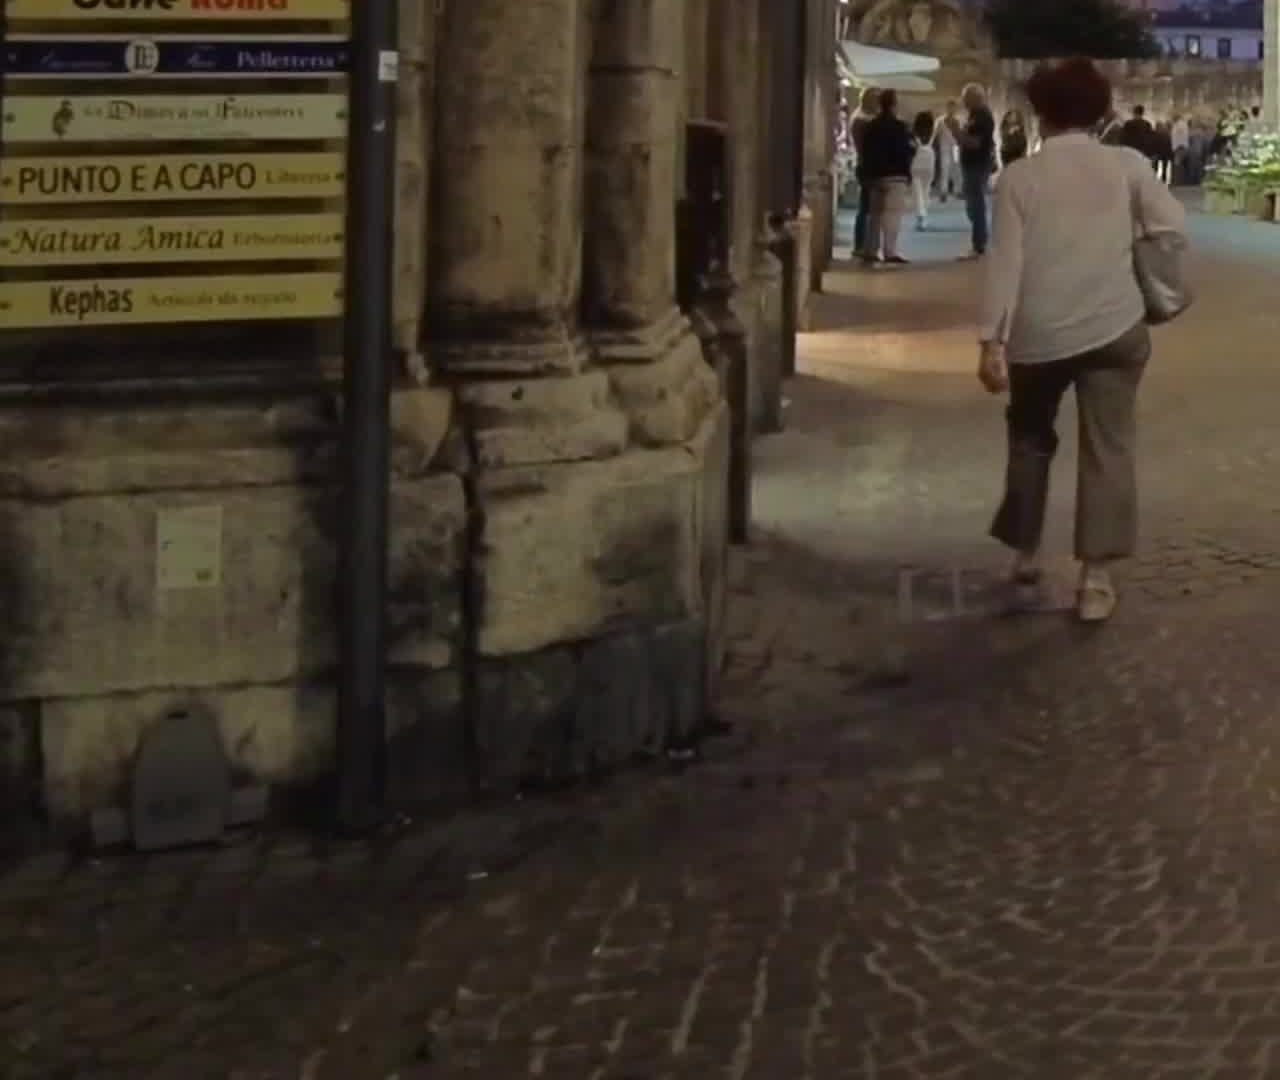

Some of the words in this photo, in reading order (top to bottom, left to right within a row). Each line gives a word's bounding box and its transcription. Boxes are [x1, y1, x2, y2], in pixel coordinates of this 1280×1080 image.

[18, 165, 121, 195] PUNTO
[131, 165, 145, 192] E
[153, 165, 174, 191] A
[179, 161, 256, 191] CAPO
[11, 228, 122, 256] Natura
[131, 225, 225, 252] Amica
[49, 283, 134, 321] Kephas
